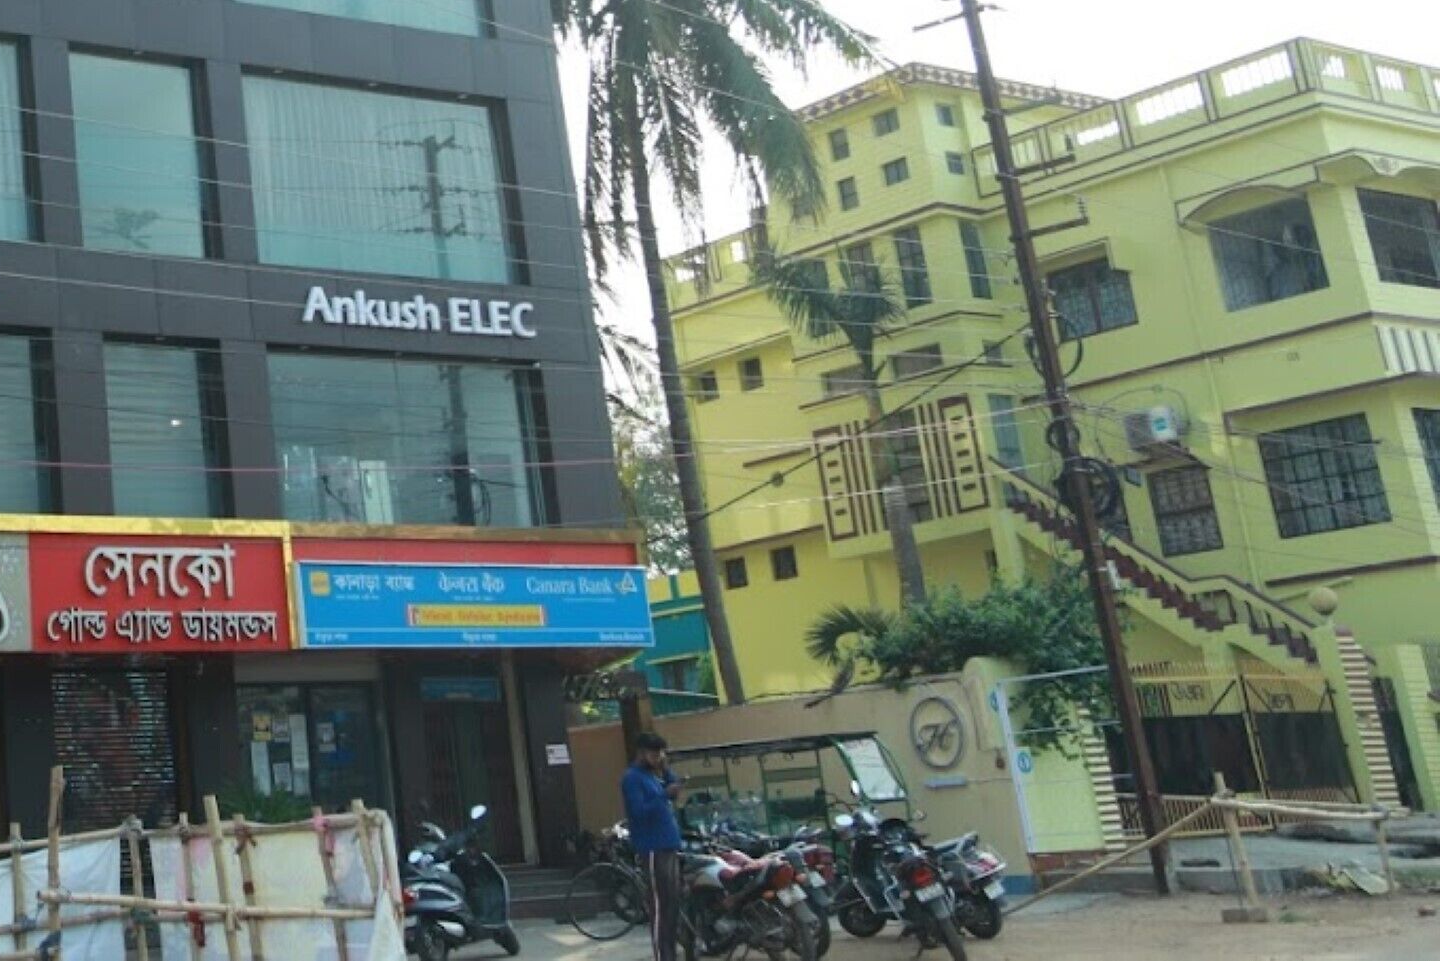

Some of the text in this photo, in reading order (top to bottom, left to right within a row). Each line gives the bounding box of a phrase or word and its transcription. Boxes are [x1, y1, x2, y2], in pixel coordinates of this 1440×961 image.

[302, 285, 538, 338] Ankush ELEC
[85, 542, 237, 598] সেনকো
[526, 576, 613, 595] Canara Bank
[47, 606, 109, 644] গোল্ড
